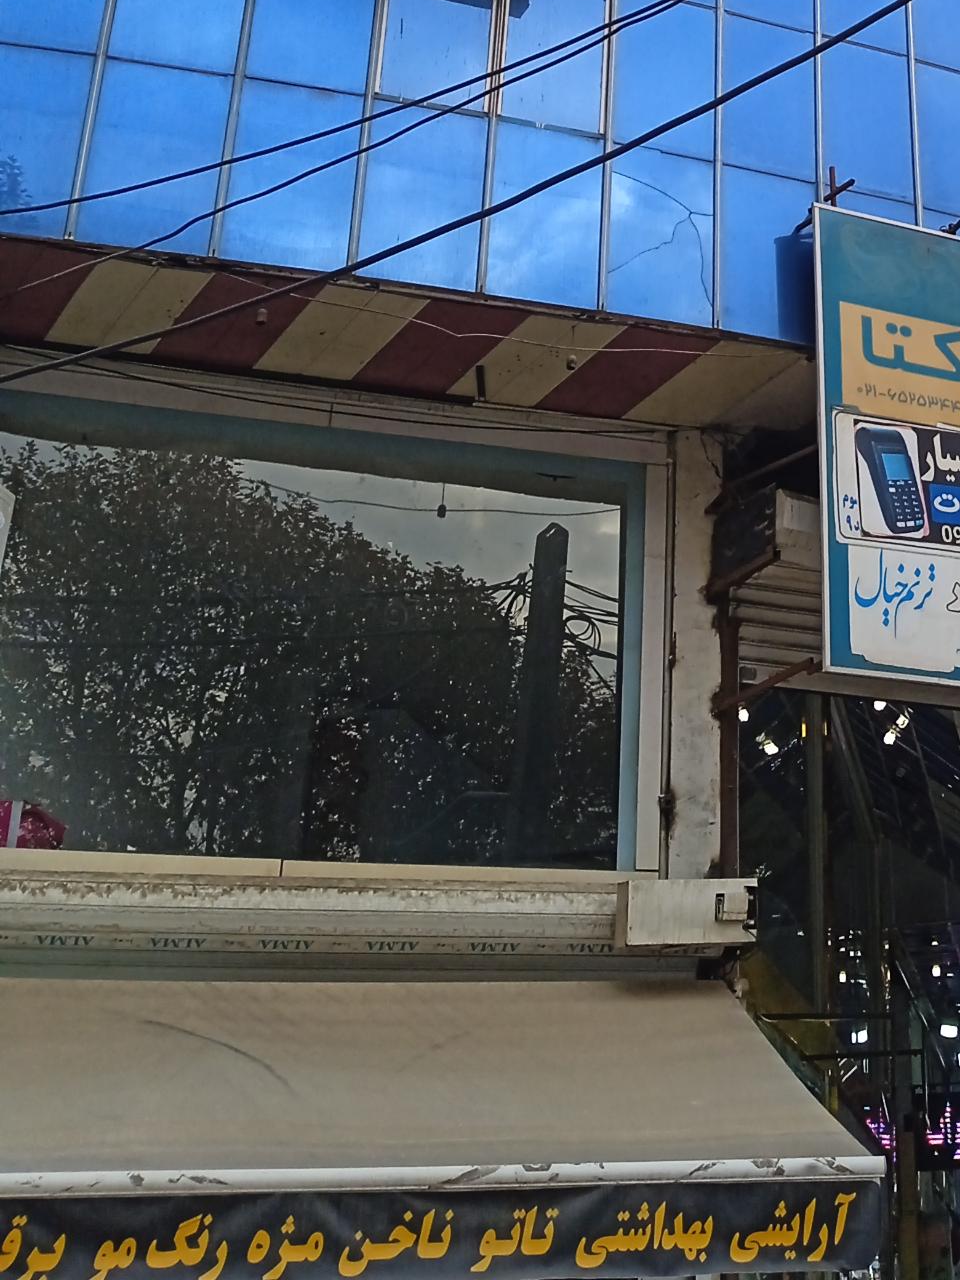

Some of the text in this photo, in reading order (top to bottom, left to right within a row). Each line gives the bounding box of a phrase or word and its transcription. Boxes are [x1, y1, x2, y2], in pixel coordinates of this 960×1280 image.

[88, 1237, 138, 1280] مو
[145, 1213, 230, 1280] رنگ
[246, 1214, 326, 1280] مژه
[337, 1207, 455, 1279] ناخن
[469, 1206, 560, 1274] تاتو
[574, 1198, 714, 1270] بهداشتی
[729, 1191, 857, 1264] آرایشی
